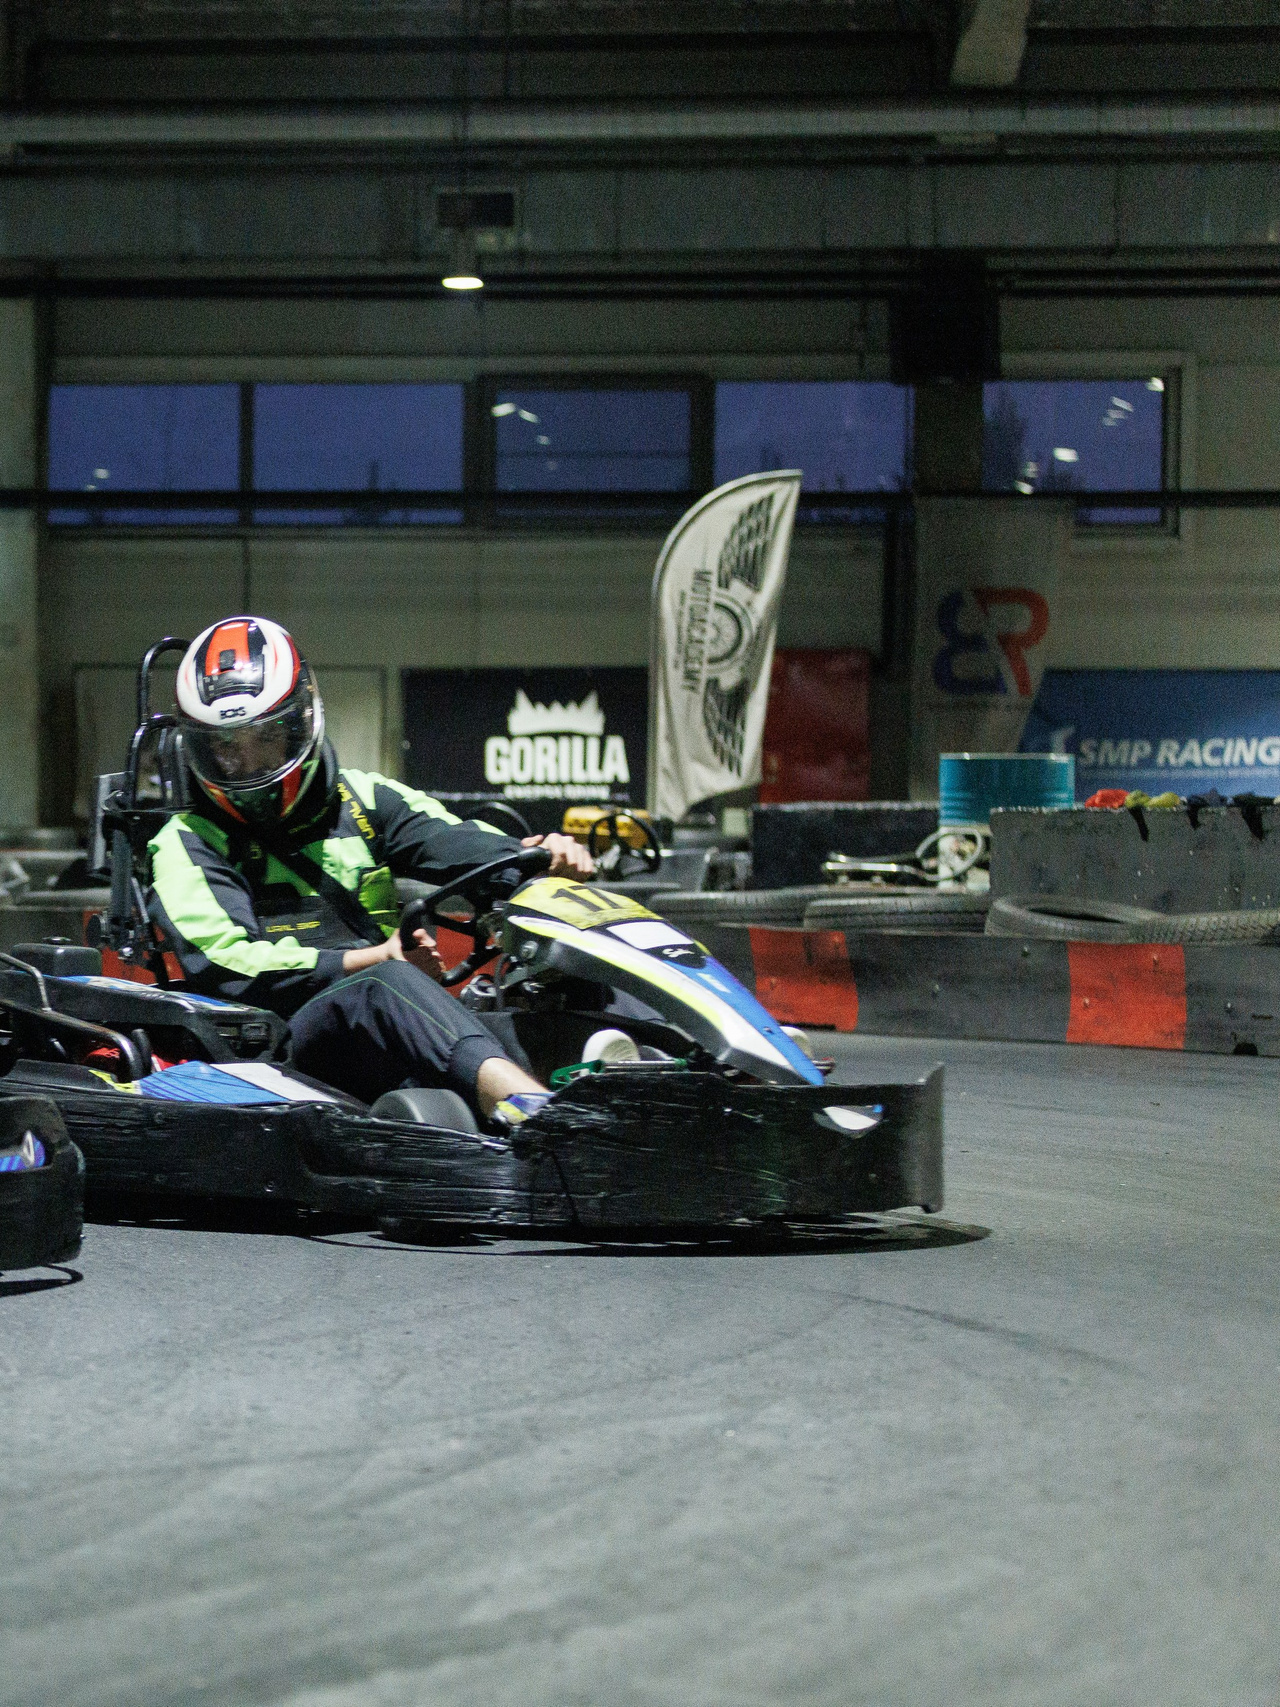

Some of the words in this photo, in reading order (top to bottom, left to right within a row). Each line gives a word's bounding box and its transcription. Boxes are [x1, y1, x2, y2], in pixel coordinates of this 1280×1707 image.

[485, 735, 630, 784] GORILLA
[1078, 738, 1152, 767] SMP
[1156, 736, 1280, 767] RACING
[551, 885, 623, 912] 17
